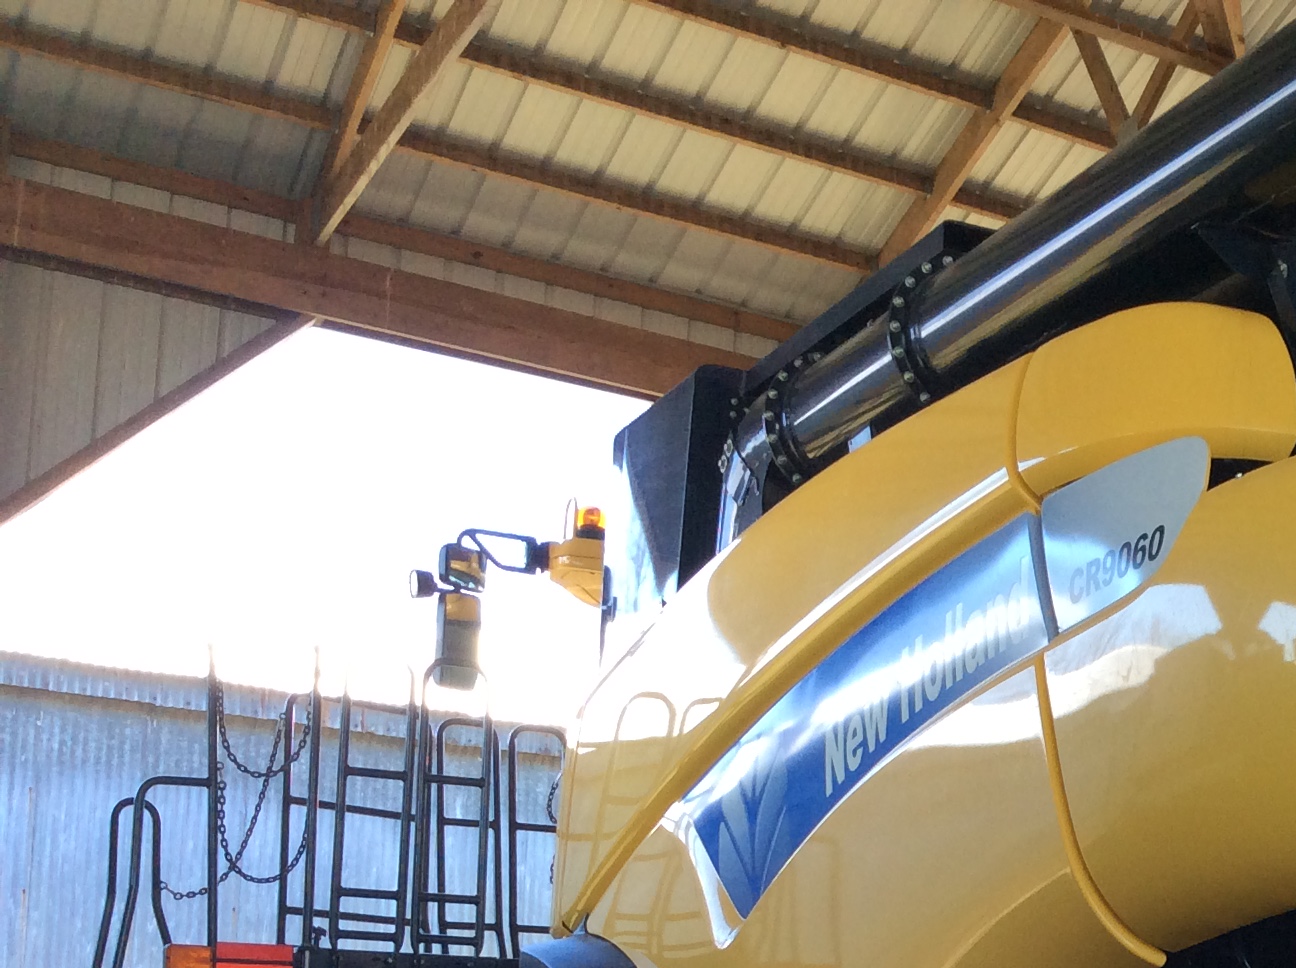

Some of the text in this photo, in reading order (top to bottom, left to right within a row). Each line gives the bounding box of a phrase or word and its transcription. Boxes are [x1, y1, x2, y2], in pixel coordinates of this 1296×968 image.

[1069, 524, 1166, 605] CR9060
[823, 557, 1029, 797] New Holland
